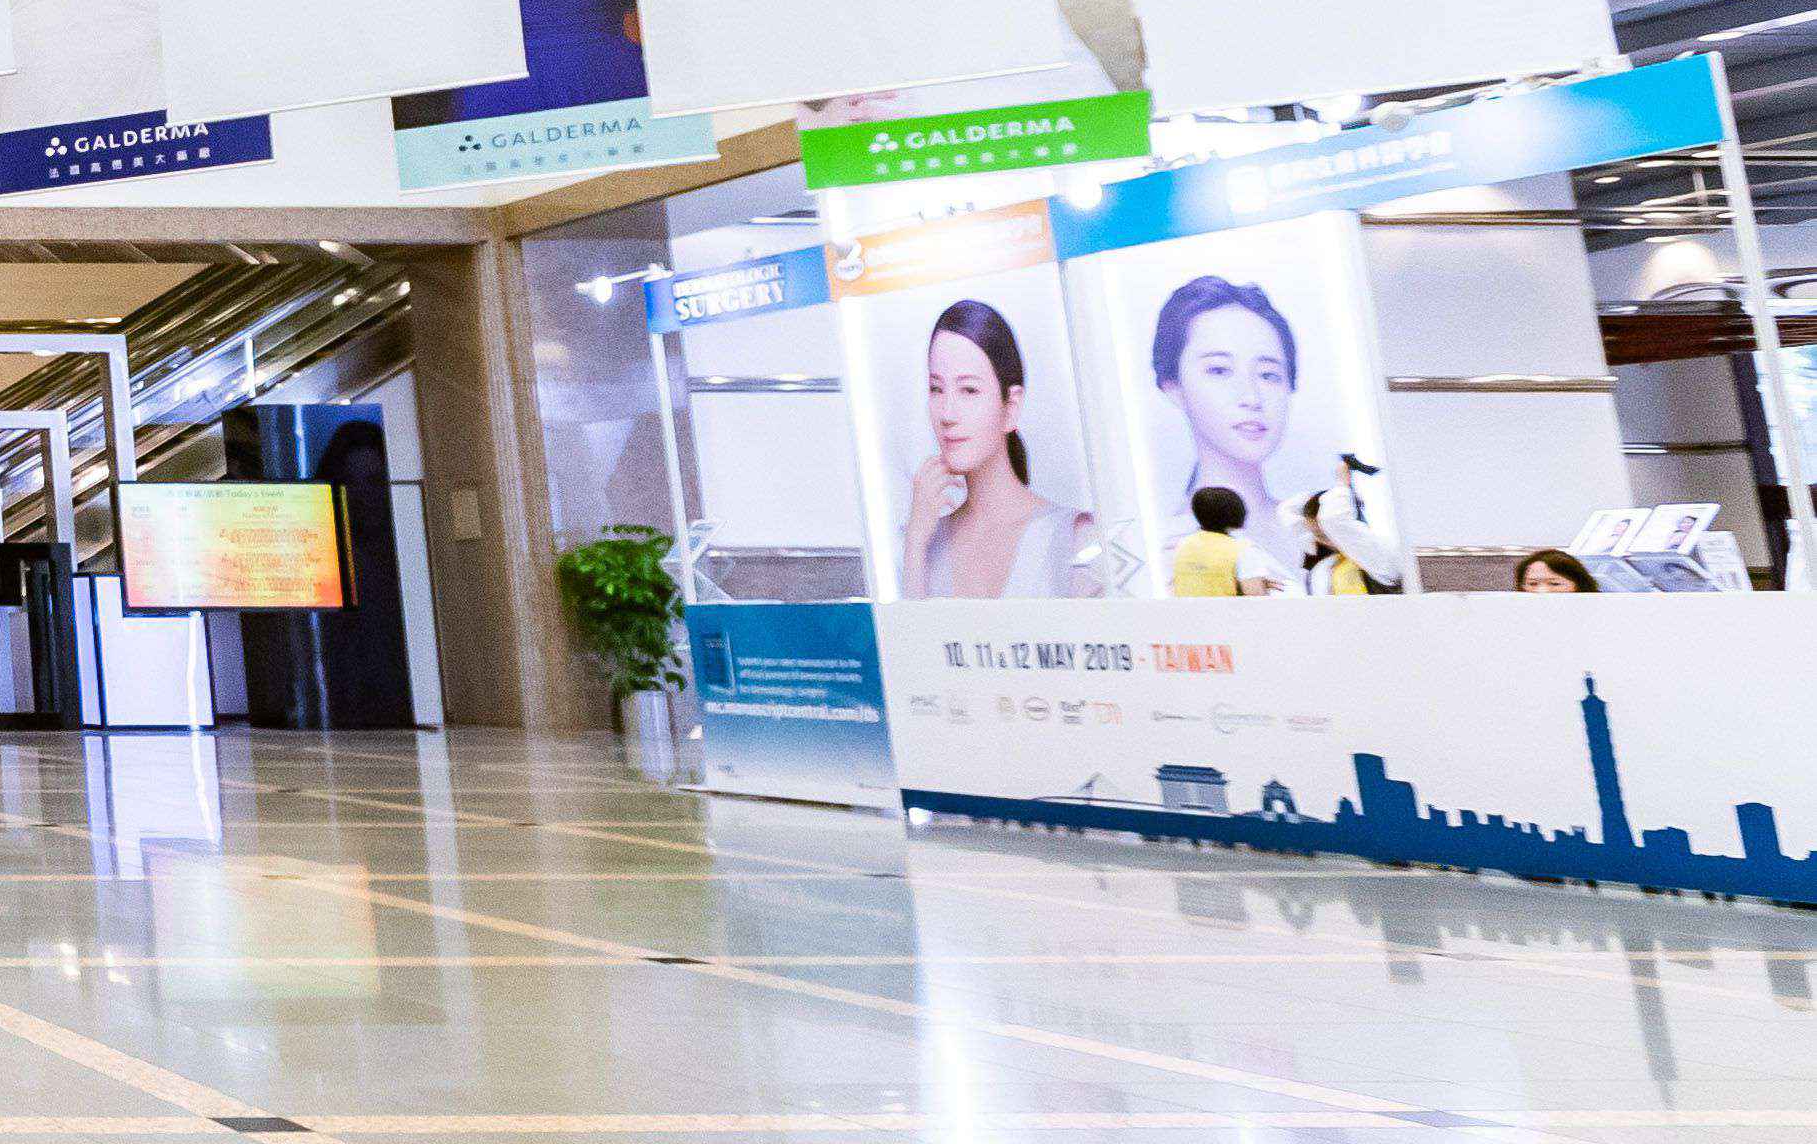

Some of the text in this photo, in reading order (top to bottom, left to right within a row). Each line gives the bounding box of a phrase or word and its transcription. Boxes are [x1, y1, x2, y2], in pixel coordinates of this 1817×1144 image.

[74, 123, 210, 154] GALDERMA
[491, 116, 643, 149] GALDERMA
[905, 116, 1076, 150] GALDERMA
[674, 280, 786, 323] SURGERY
[974, 642, 995, 669] 11
[1011, 642, 1031, 670] 12
[1036, 643, 1076, 670] MAY
[1084, 643, 1134, 671] 2019
[1150, 643, 1235, 673] TAIWAN
